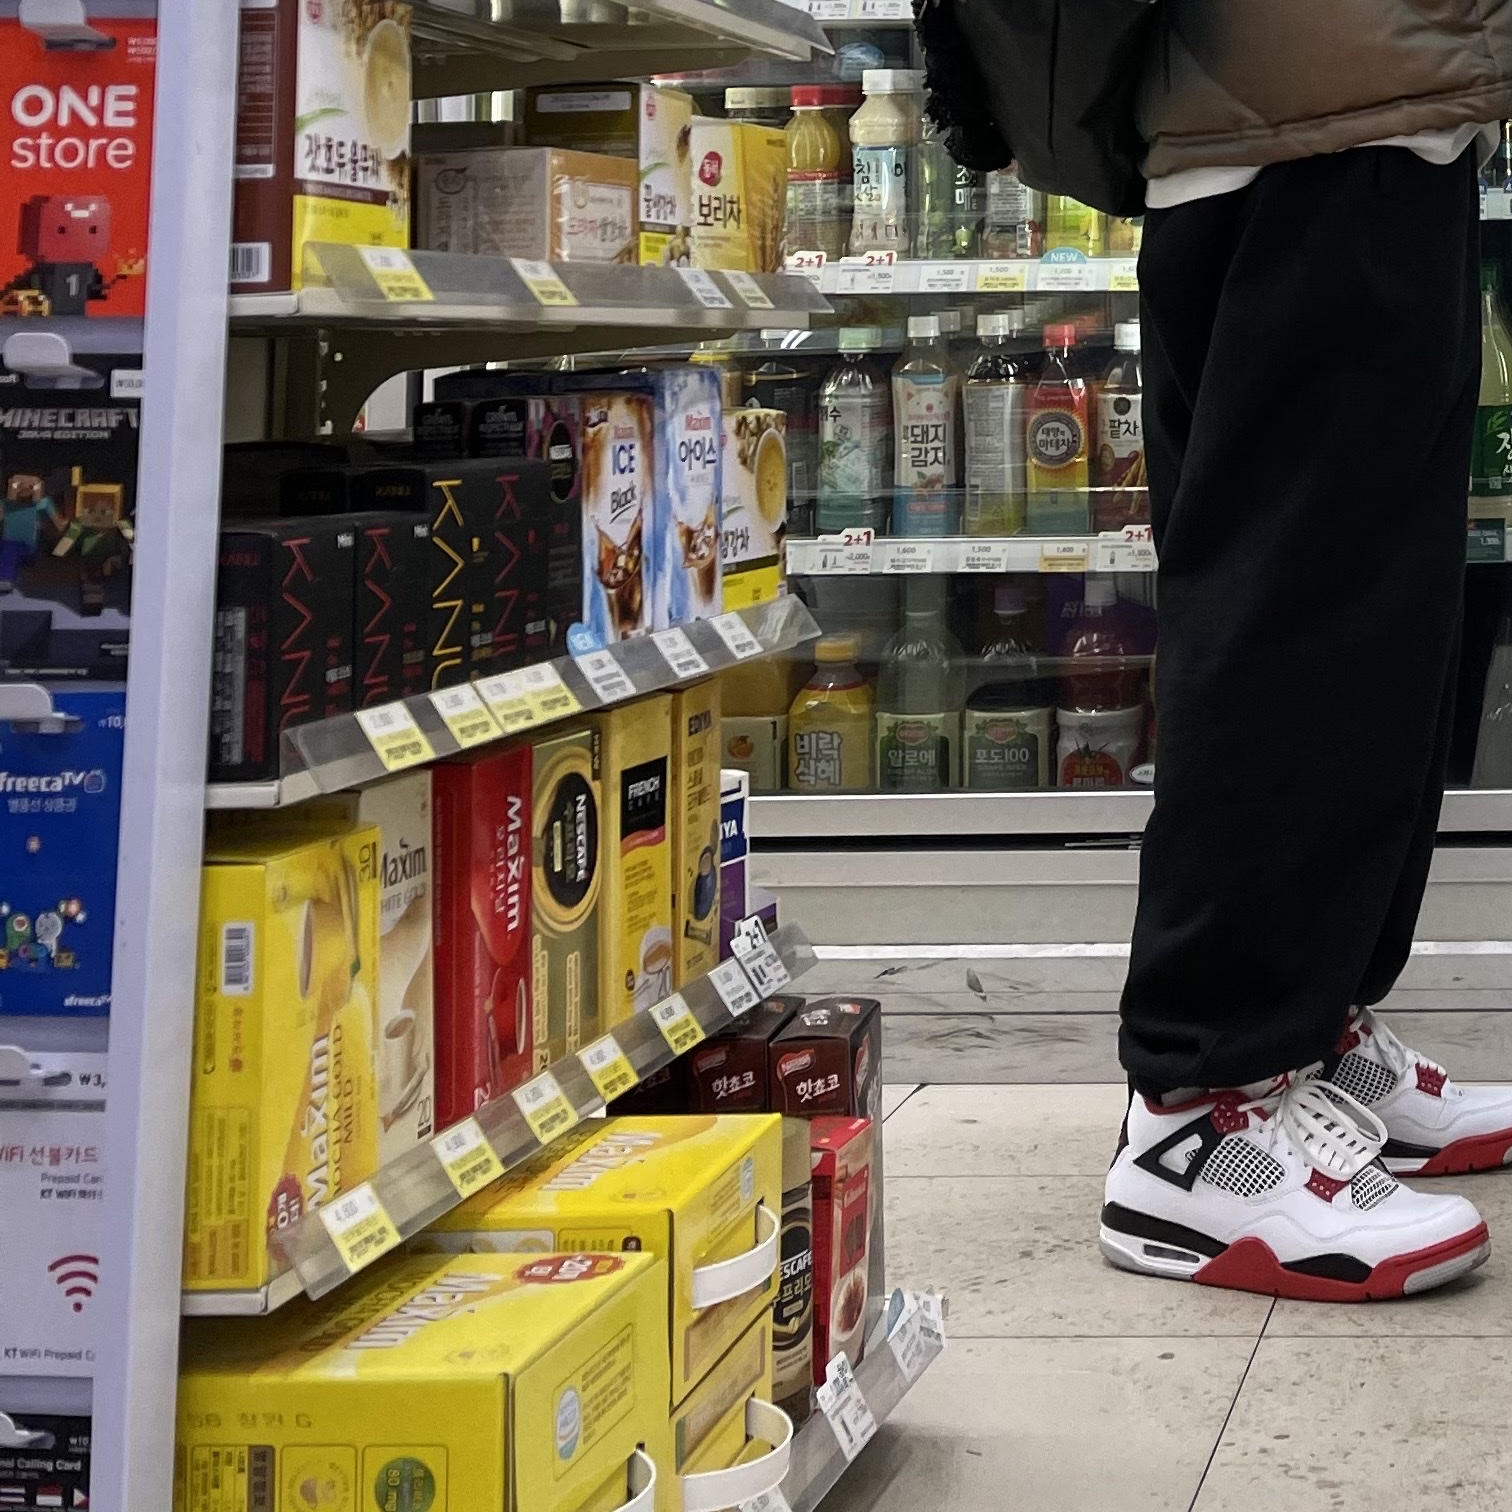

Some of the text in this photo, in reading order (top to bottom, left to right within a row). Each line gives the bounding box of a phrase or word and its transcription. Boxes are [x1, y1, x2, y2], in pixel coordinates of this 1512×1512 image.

[11, 85, 138, 128] ONE
[10, 135, 136, 169] store
[696, 194, 743, 230] 보리차
[796, 254, 824, 269] 2+1
[866, 253, 895, 267] 2+1
[1050, 251, 1078, 263] NEW
[0, 407, 139, 428] MINECRAFT
[1108, 419, 1140, 441] 팥차
[909, 424, 948, 446] 돼지
[611, 443, 636, 476] ICE
[678, 436, 718, 471] 아이스
[610, 480, 637, 514] Black
[843, 531, 874, 547] 2+1
[1125, 527, 1153, 543] 2+1
[795, 731, 844, 762] 비락
[887, 747, 937, 768] 알로에
[975, 747, 1030, 765] 포도100
[0, 771, 85, 792] freecaTV
[795, 758, 842, 787] 식혜
[506, 795, 523, 931] Maxim
[796, 1074, 841, 1103] 핫쵸코
[302, 1033, 331, 1214] Maxim
